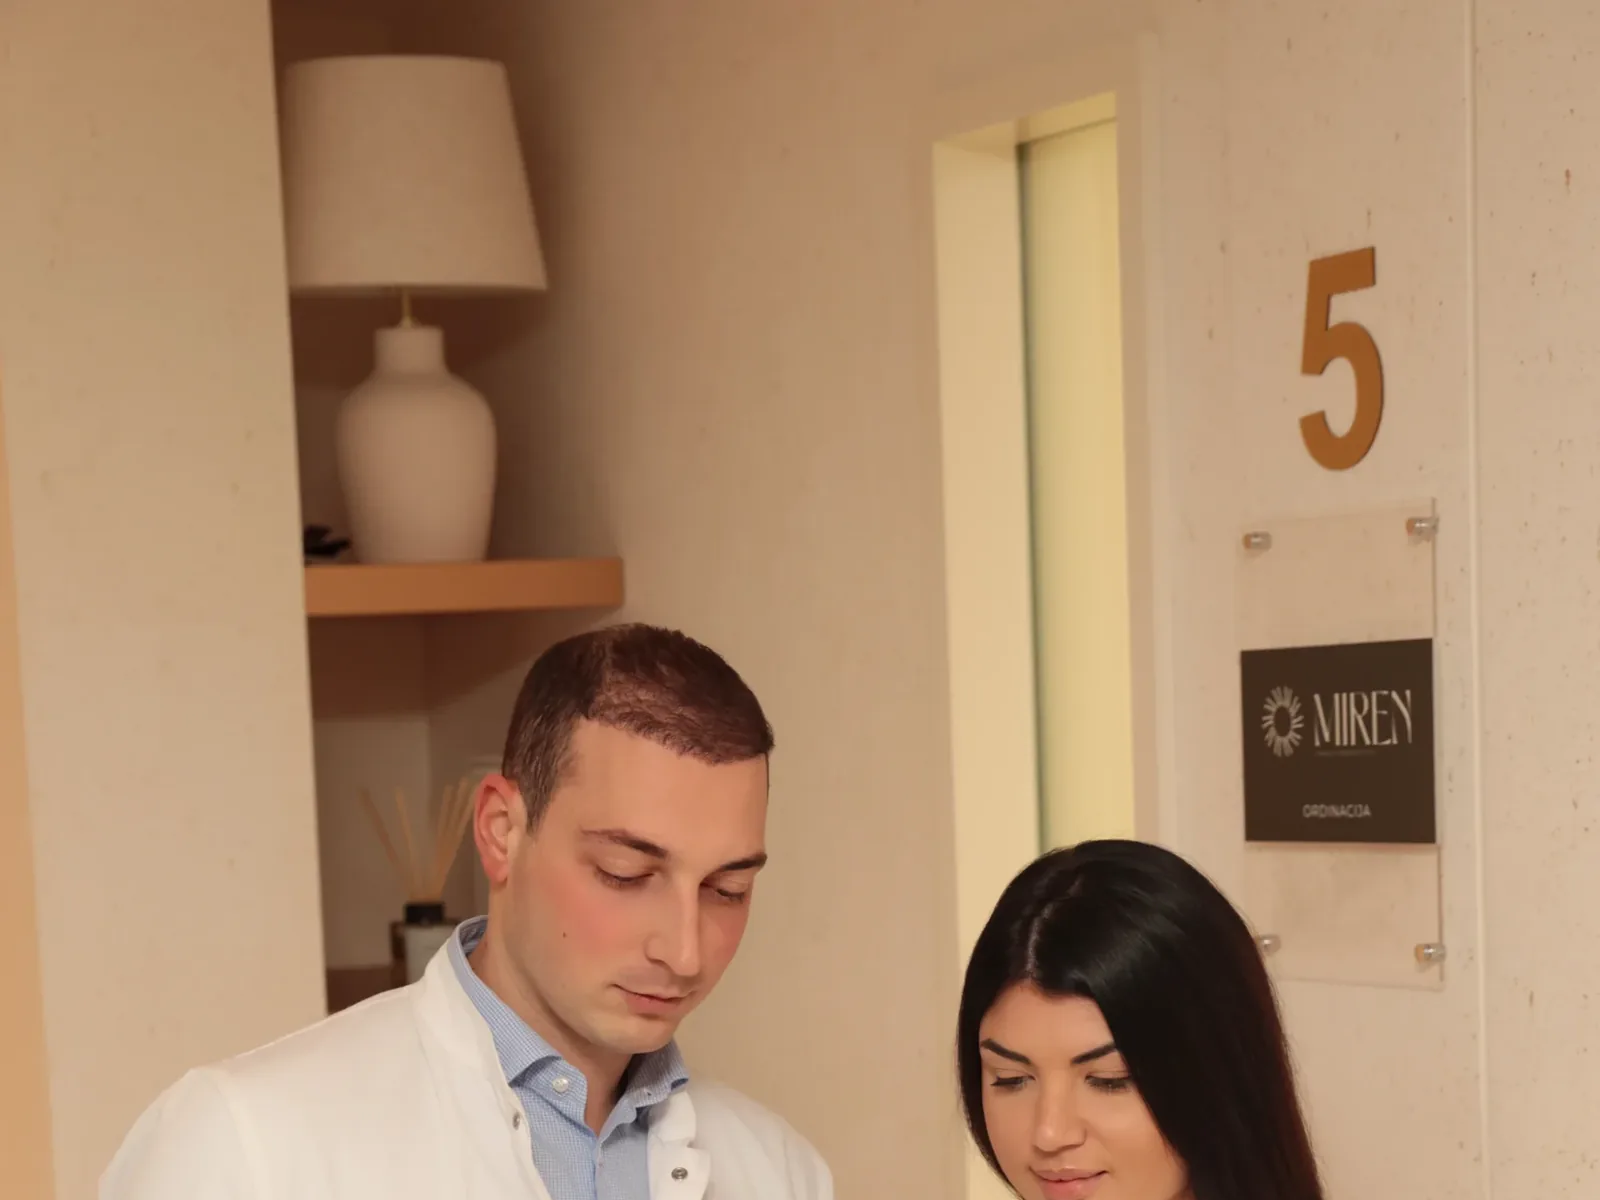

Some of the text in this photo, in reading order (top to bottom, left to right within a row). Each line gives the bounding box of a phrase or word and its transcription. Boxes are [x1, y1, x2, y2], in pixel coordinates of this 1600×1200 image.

[1299, 246, 1384, 471] 5
[1313, 688, 1412, 747] MIREN
[1302, 804, 1371, 818] ORDINACIJA
